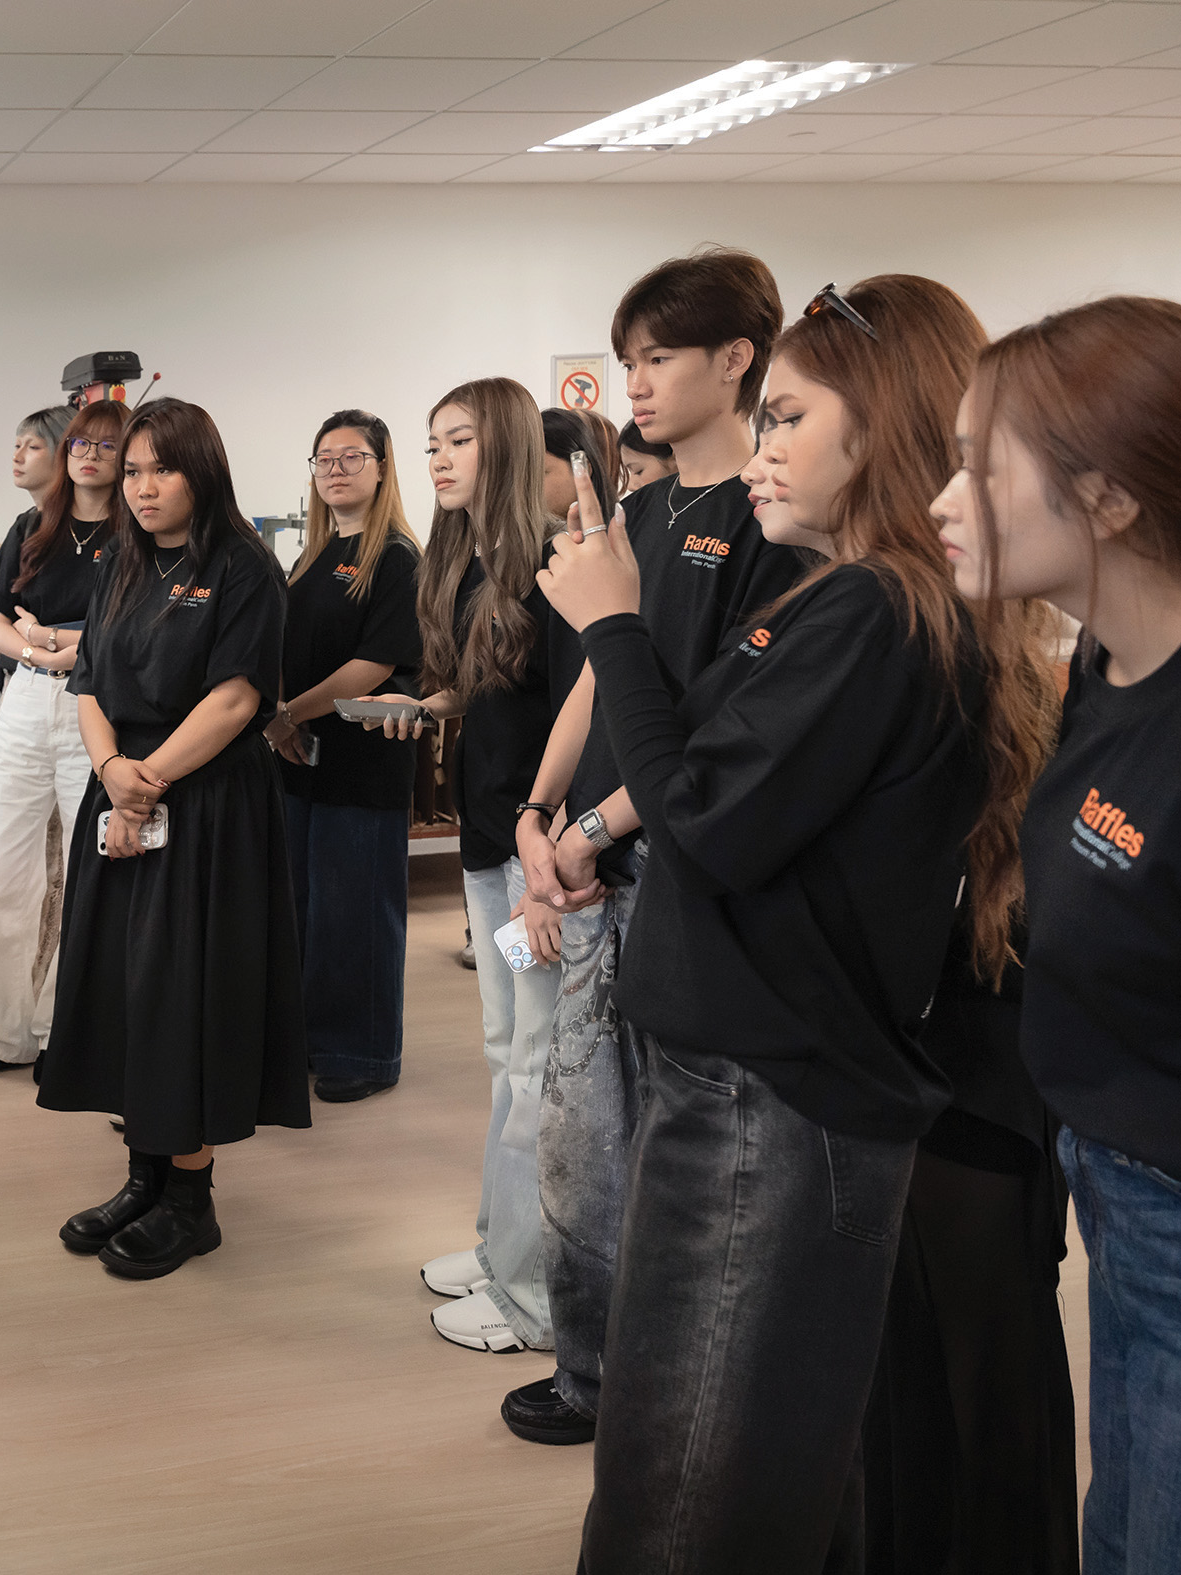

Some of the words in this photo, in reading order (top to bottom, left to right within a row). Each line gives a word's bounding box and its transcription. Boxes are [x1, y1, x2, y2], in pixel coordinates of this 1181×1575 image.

[170, 584, 212, 598] Rales
[739, 642, 762, 657] llege
[1079, 787, 1145, 857] Raffles
